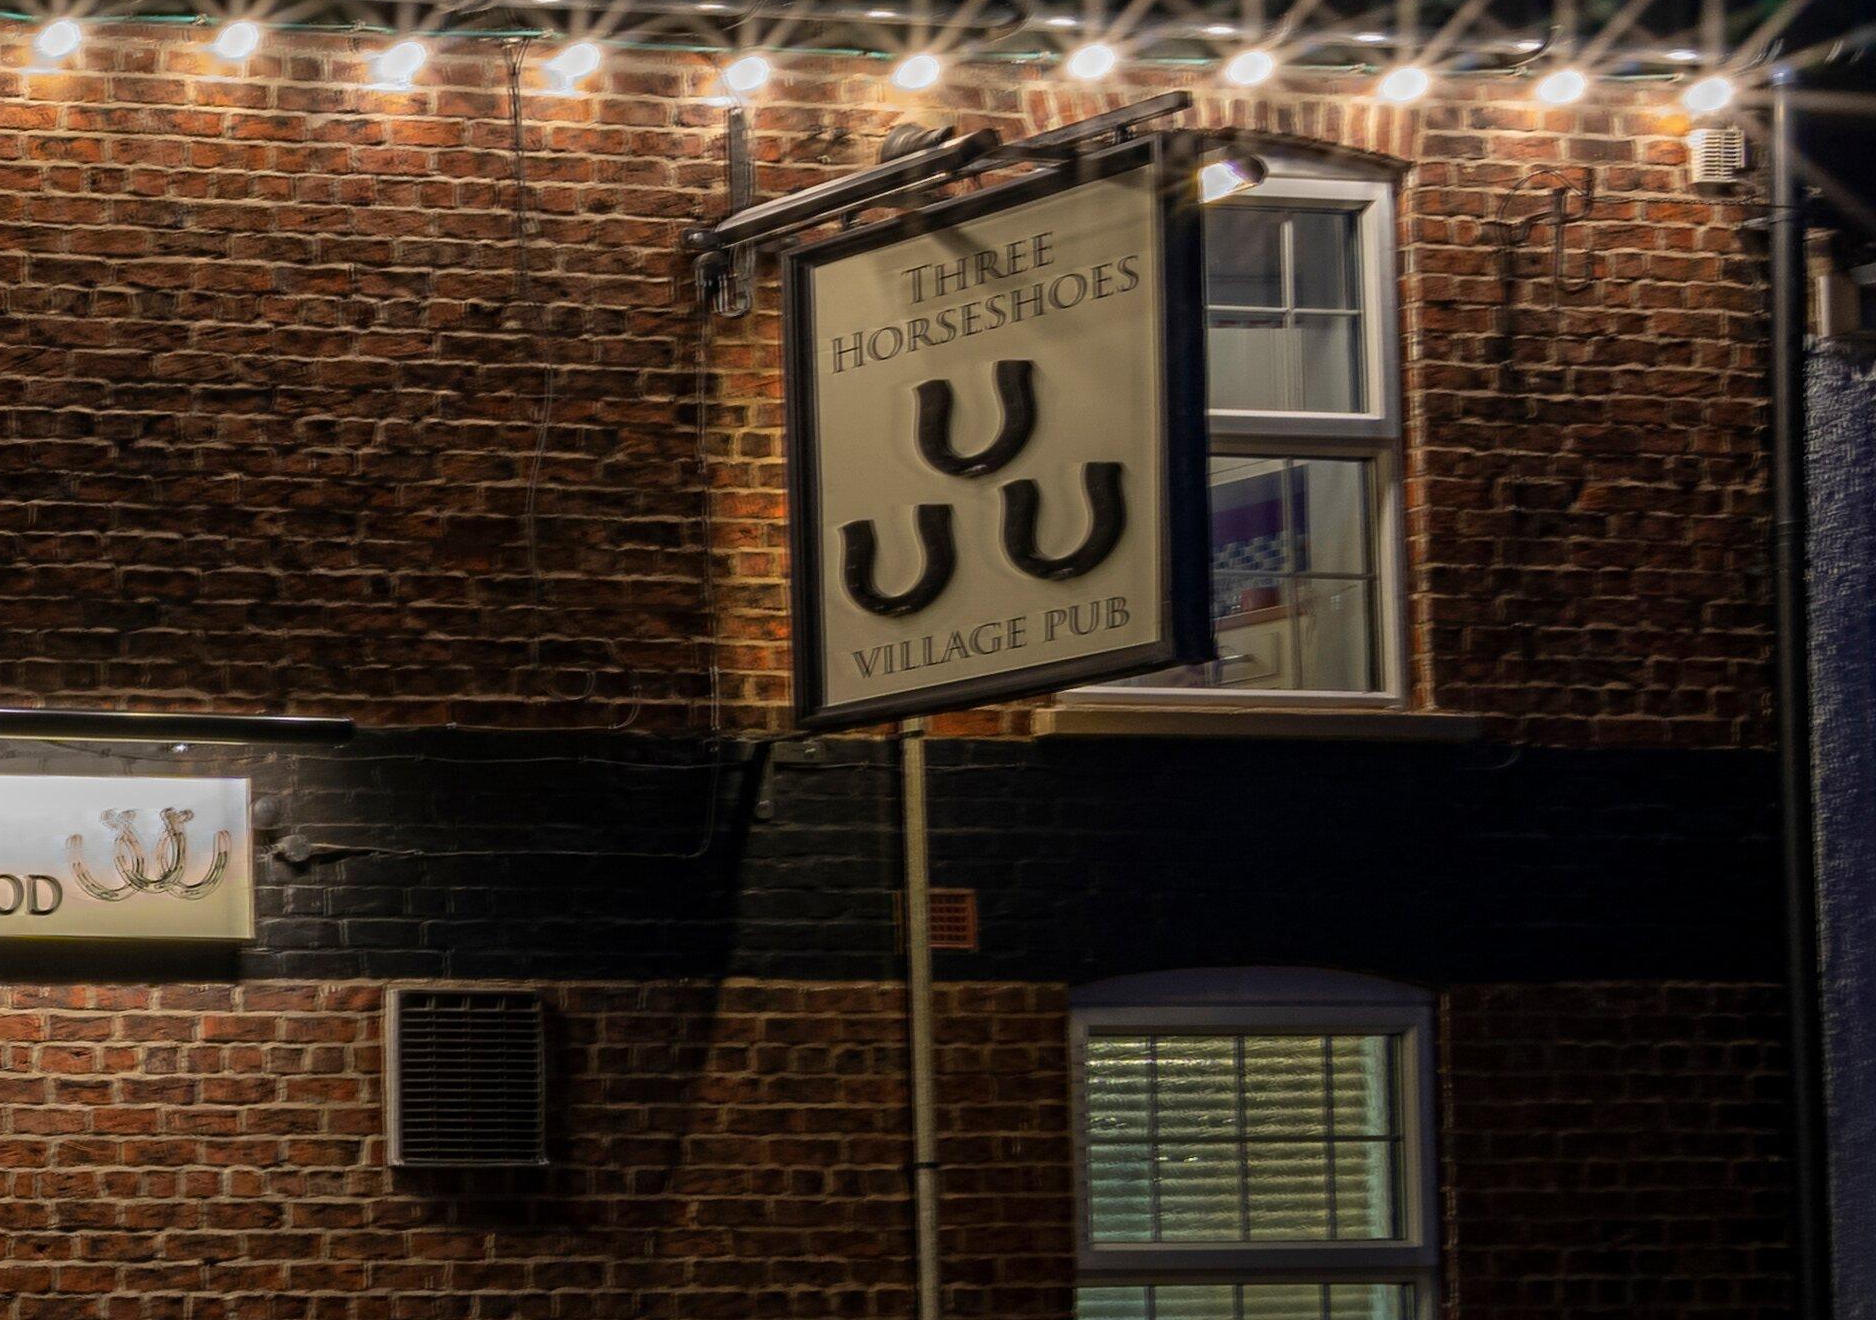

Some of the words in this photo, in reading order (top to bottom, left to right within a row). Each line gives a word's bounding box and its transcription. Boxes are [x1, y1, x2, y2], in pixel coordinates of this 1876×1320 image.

[901, 231, 1055, 305] THREE
[830, 255, 1140, 374] HORSESHOES
[851, 616, 1028, 679] VILLAGE
[1043, 596, 1131, 643] PUB
